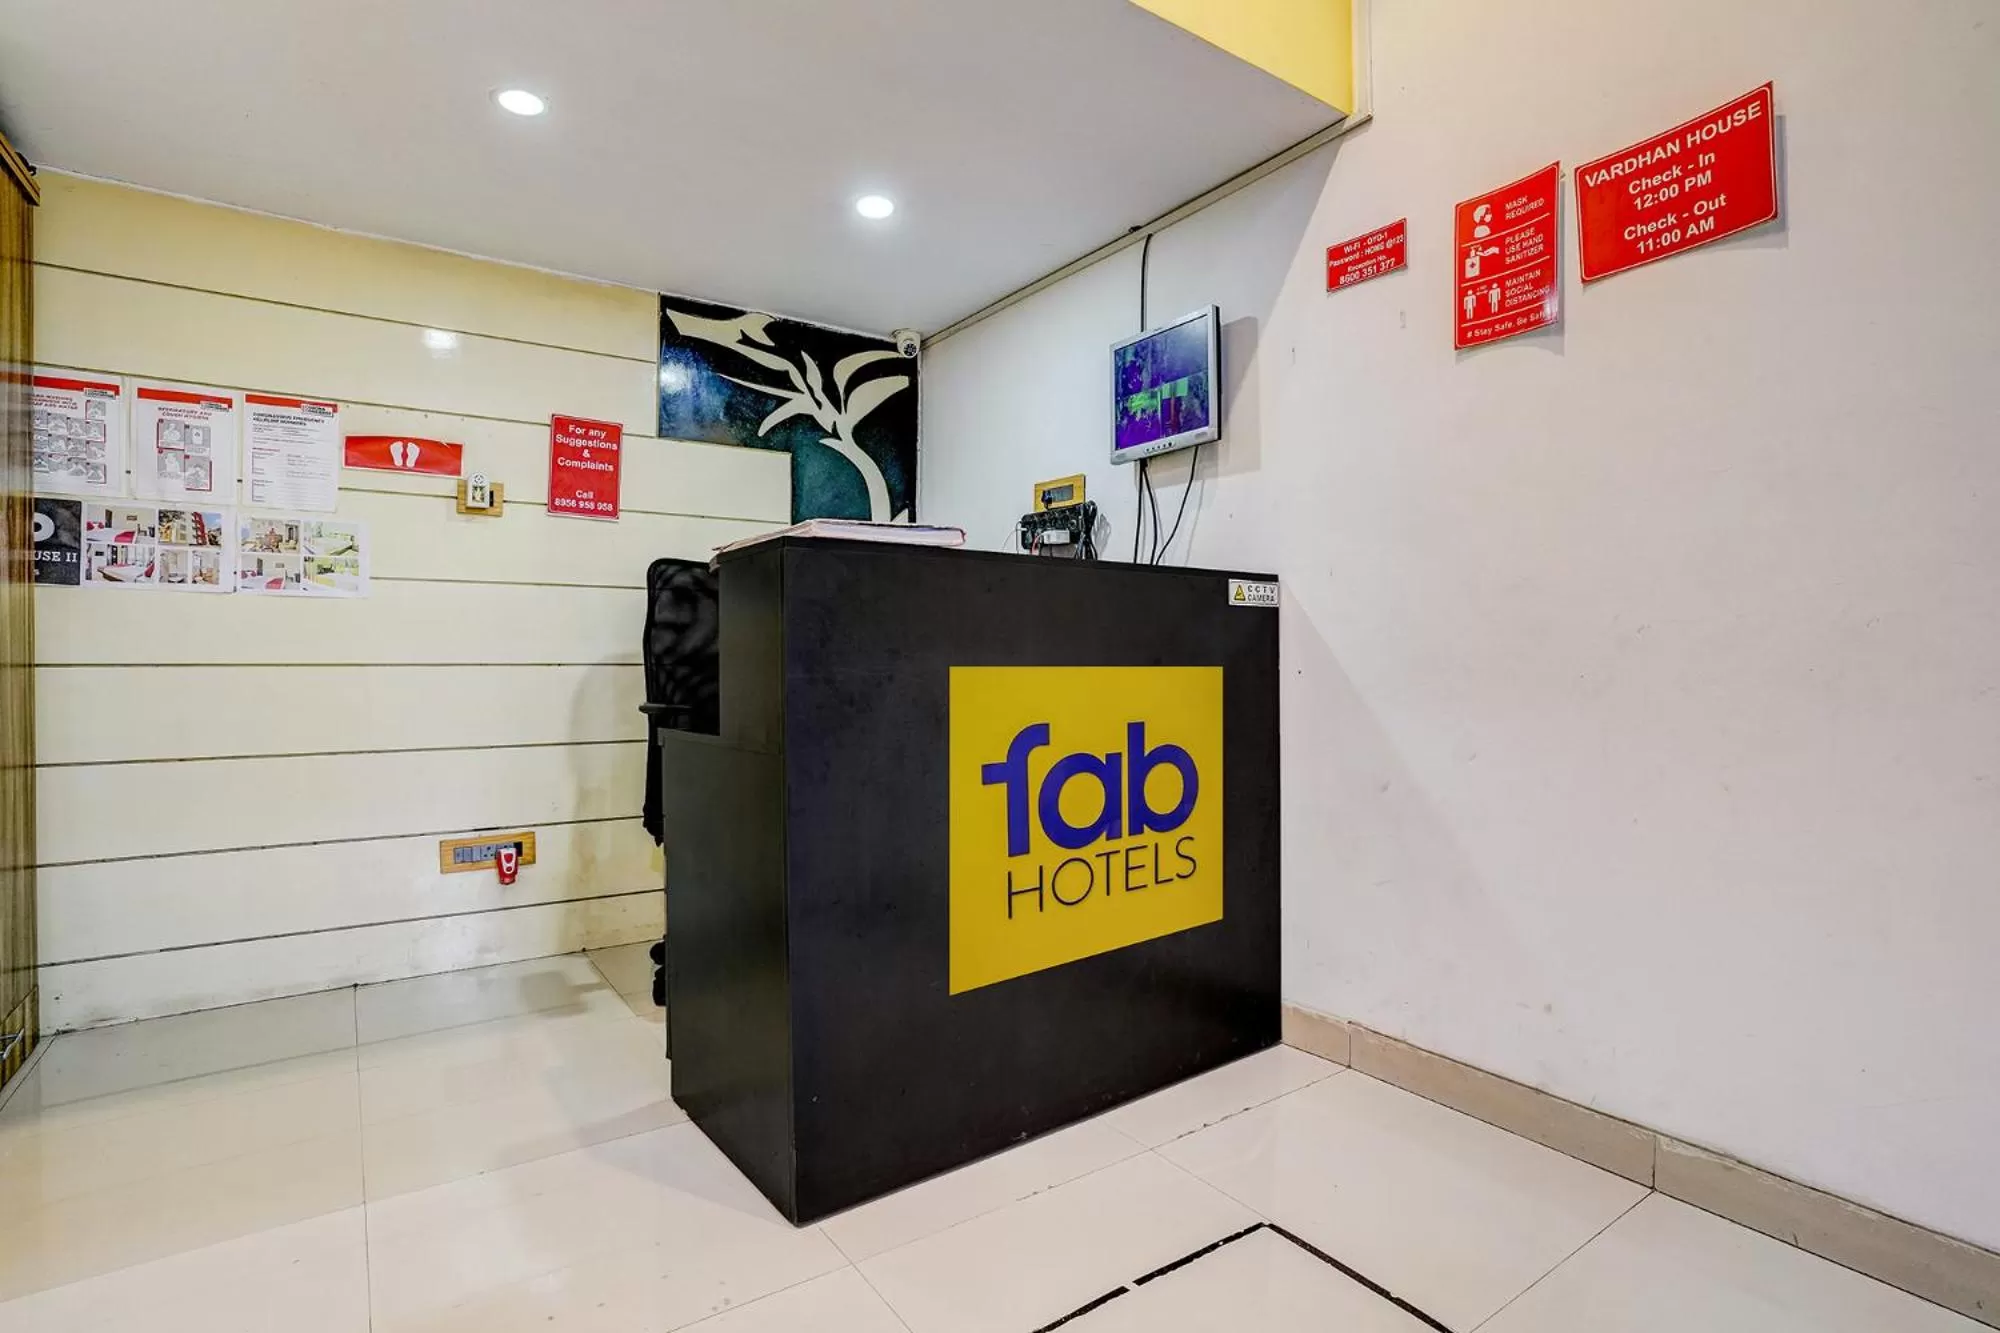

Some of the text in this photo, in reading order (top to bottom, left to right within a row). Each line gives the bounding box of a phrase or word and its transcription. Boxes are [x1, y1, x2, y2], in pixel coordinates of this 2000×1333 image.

[1585, 100, 1762, 188] VARDHAN HOUSE
[1628, 164, 1682, 195] Check
[1698, 151, 1716, 167] In
[1634, 170, 1712, 210] 12:00 PM
[1504, 196, 1529, 210] MASK
[1504, 197, 1545, 220] REQUIRED
[1624, 211, 1677, 241] Check
[1693, 193, 1727, 216] Out
[1504, 227, 1536, 244] PLEASE
[1504, 234, 1544, 255] USE HAND
[1637, 217, 1715, 254] 11:00 AM
[1504, 245, 1544, 265] SANITIZER
[1362, 265, 1376, 277] 351
[1380, 258, 1395, 270] 377
[1504, 269, 1541, 287] MAINTAIN
[1504, 283, 1534, 298] SOCIAL
[1504, 287, 1550, 308] DISTANCING
[1474, 327, 1492, 337] Stay
[1516, 316, 1528, 325] Be
[569, 425, 607, 438] For any
[556, 434, 618, 450] Suggestions
[583, 449, 591, 457] &
[557, 457, 614, 472] Complaints
[576, 490, 594, 498] Call
[33, 551, 61, 562] USE
[1247, 585, 1276, 593] CCTV
[1247, 594, 1275, 602] CAMERA
[982, 722, 1199, 857] fab
[1007, 836, 1197, 920] HOTELS
